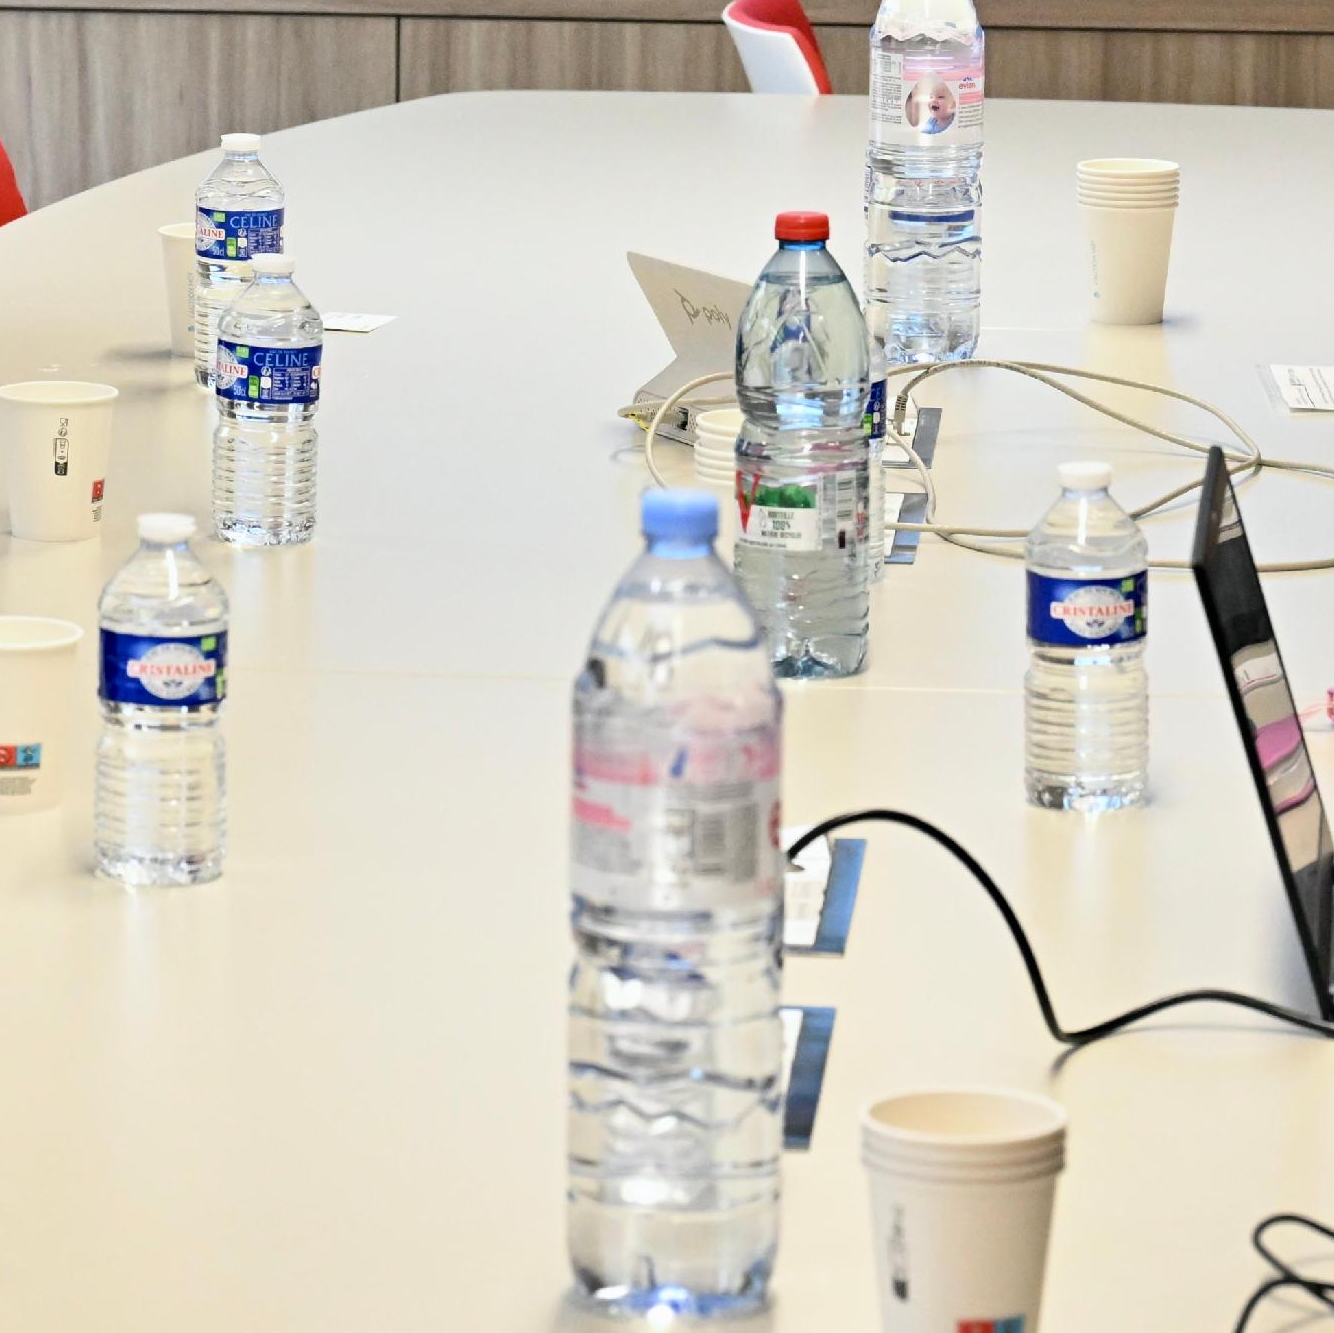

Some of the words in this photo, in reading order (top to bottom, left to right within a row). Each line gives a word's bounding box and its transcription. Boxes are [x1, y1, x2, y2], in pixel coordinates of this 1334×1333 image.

[229, 214, 278, 229] CELINE
[702, 304, 732, 331] poly
[253, 352, 309, 367] CELINE
